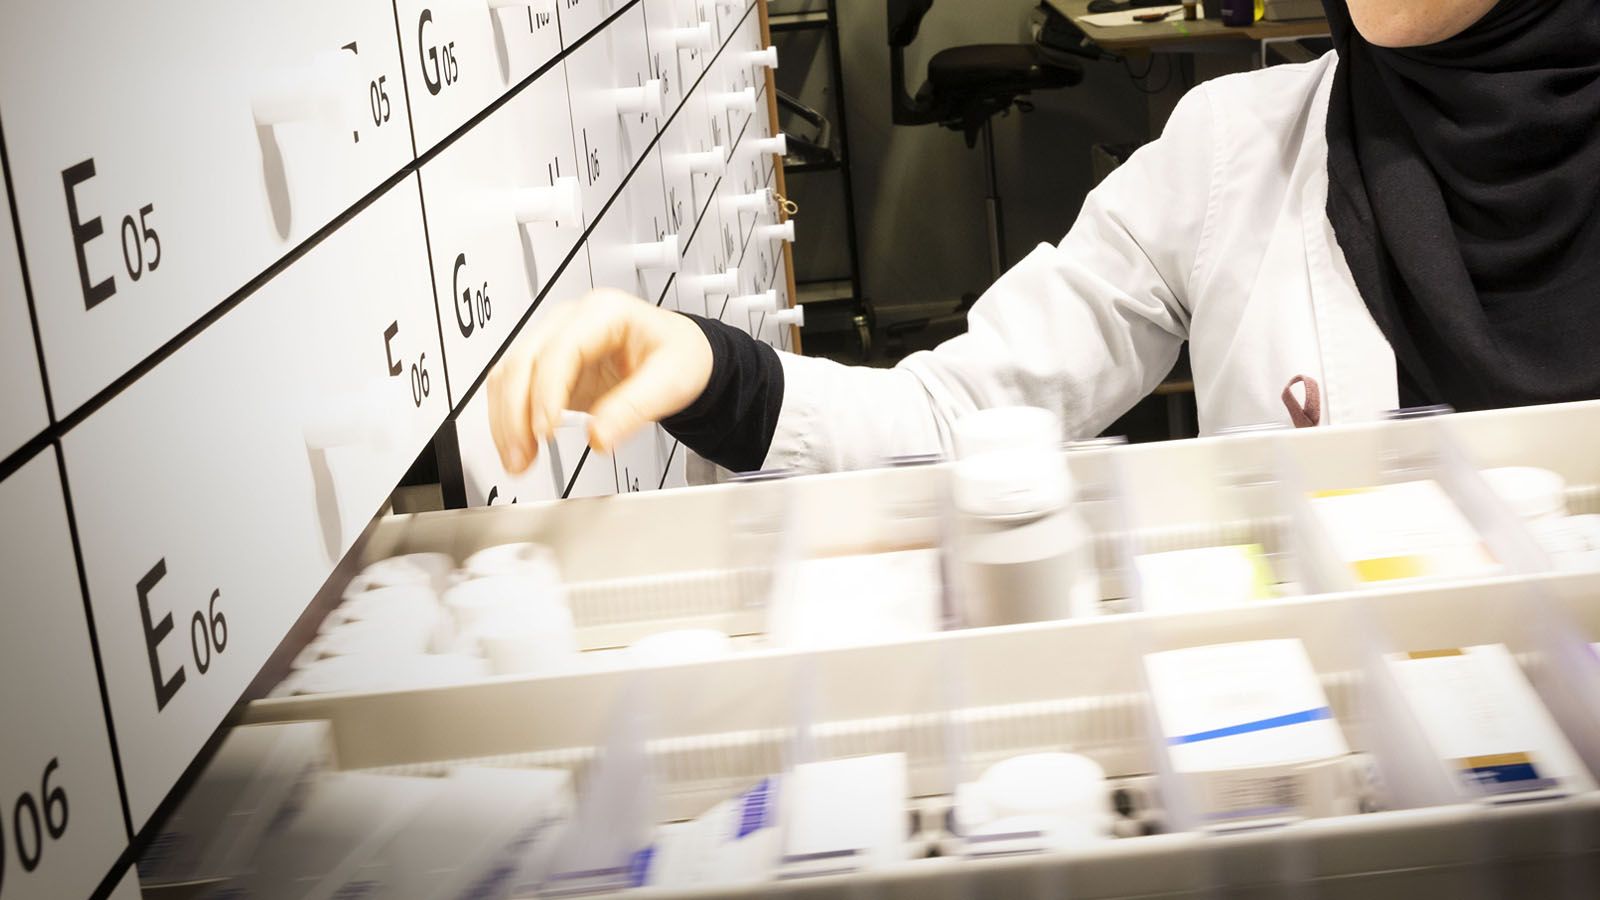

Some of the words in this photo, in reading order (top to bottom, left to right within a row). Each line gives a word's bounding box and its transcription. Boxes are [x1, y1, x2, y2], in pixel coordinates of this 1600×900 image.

[418, 8, 458, 96] G05
[61, 158, 162, 311] E05
[453, 253, 491, 338] G06
[136, 556, 228, 714] E06
